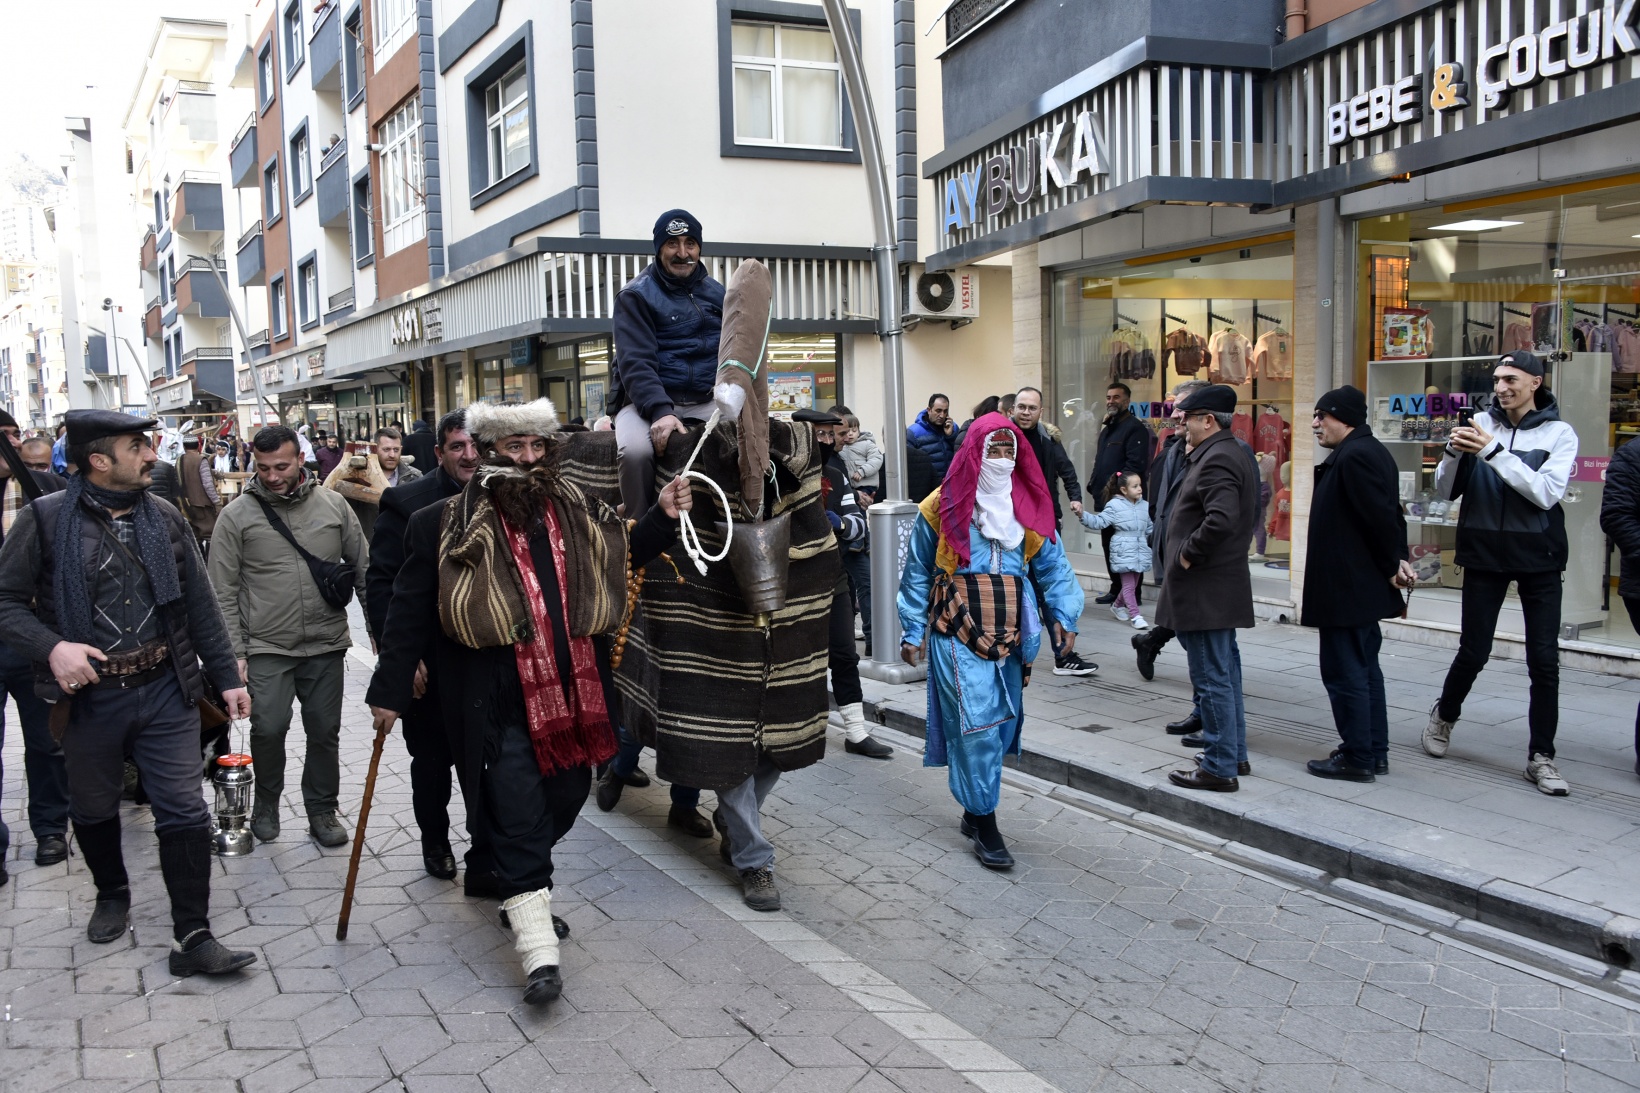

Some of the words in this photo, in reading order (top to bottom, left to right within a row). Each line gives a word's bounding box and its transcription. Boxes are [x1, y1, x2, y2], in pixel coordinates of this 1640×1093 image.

[1328, 74, 1418, 146] BEBE
[1431, 62, 1466, 111] &
[1476, 0, 1638, 109] ÇOCUK
[944, 111, 1106, 235] AYBUKA
[962, 274, 970, 310] VESTEL
[1130, 403, 1174, 417] AYBU
